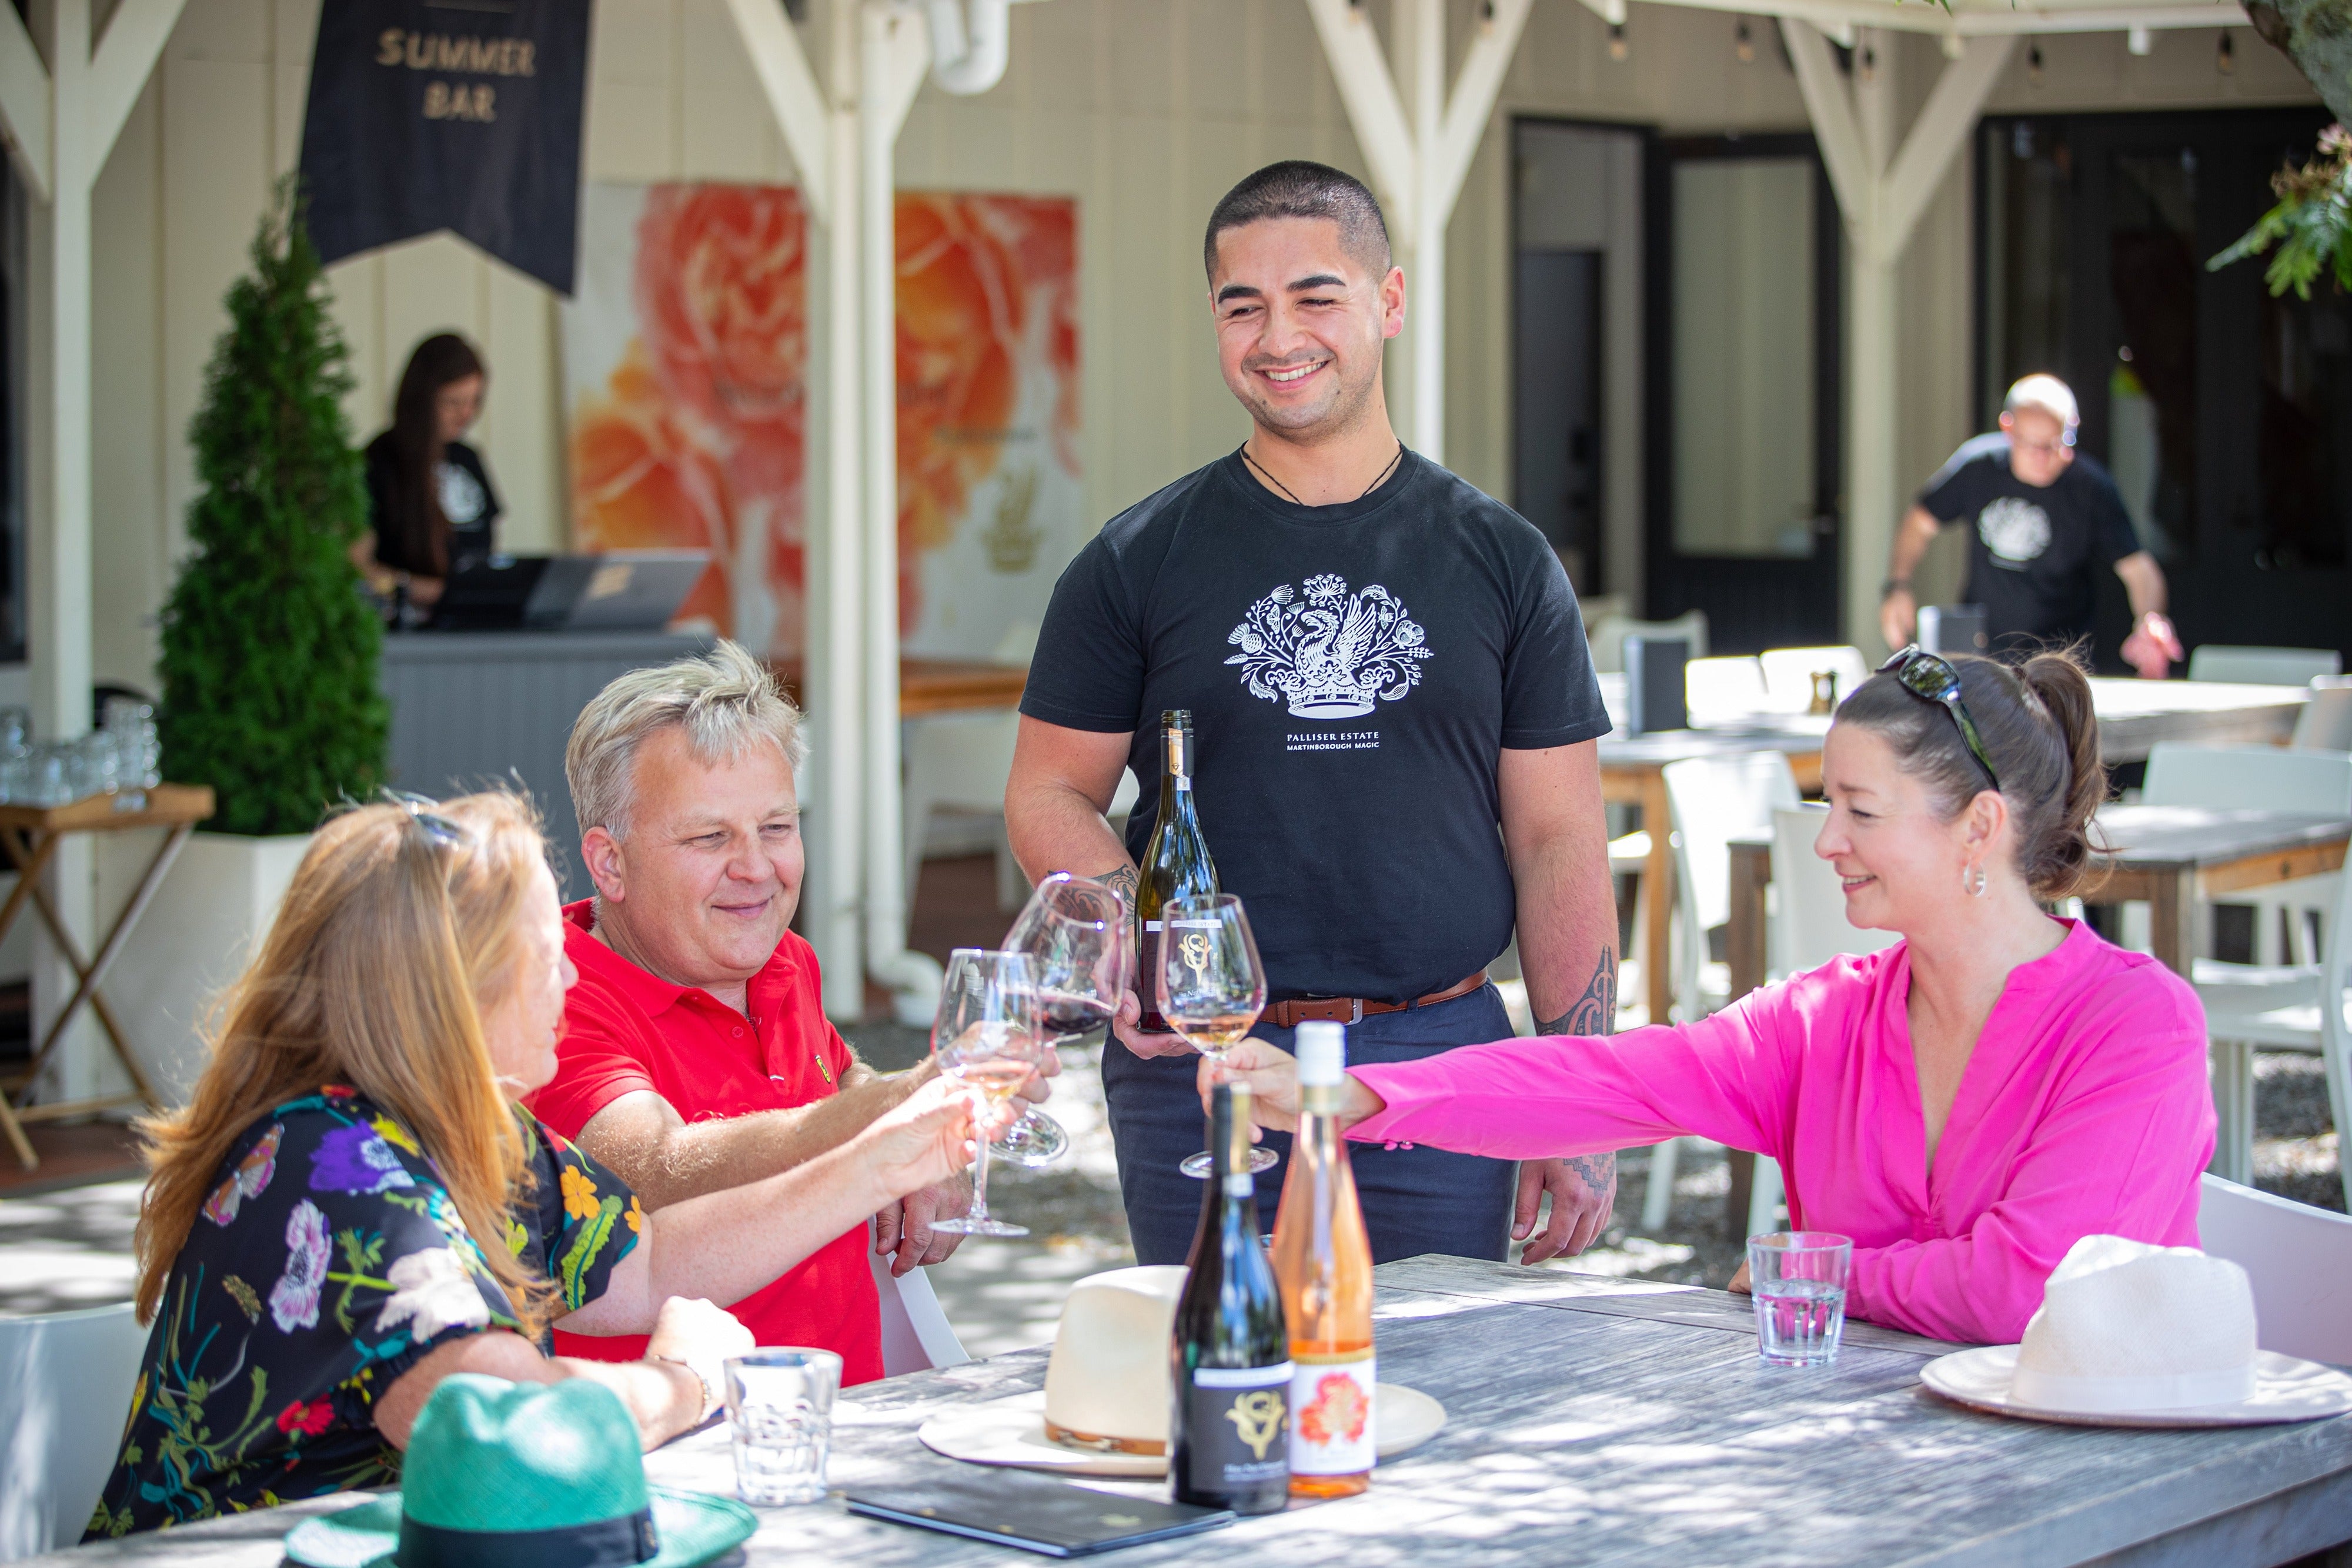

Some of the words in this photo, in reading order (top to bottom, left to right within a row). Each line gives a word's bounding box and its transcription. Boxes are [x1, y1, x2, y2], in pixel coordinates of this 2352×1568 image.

[376, 27, 536, 76] SUMMER
[423, 81, 496, 122] BAR
[1287, 733, 1337, 741] PALLISER
[1341, 731, 1379, 740] ESTATE
[1287, 743, 1352, 751] MARTINBOROUGH
